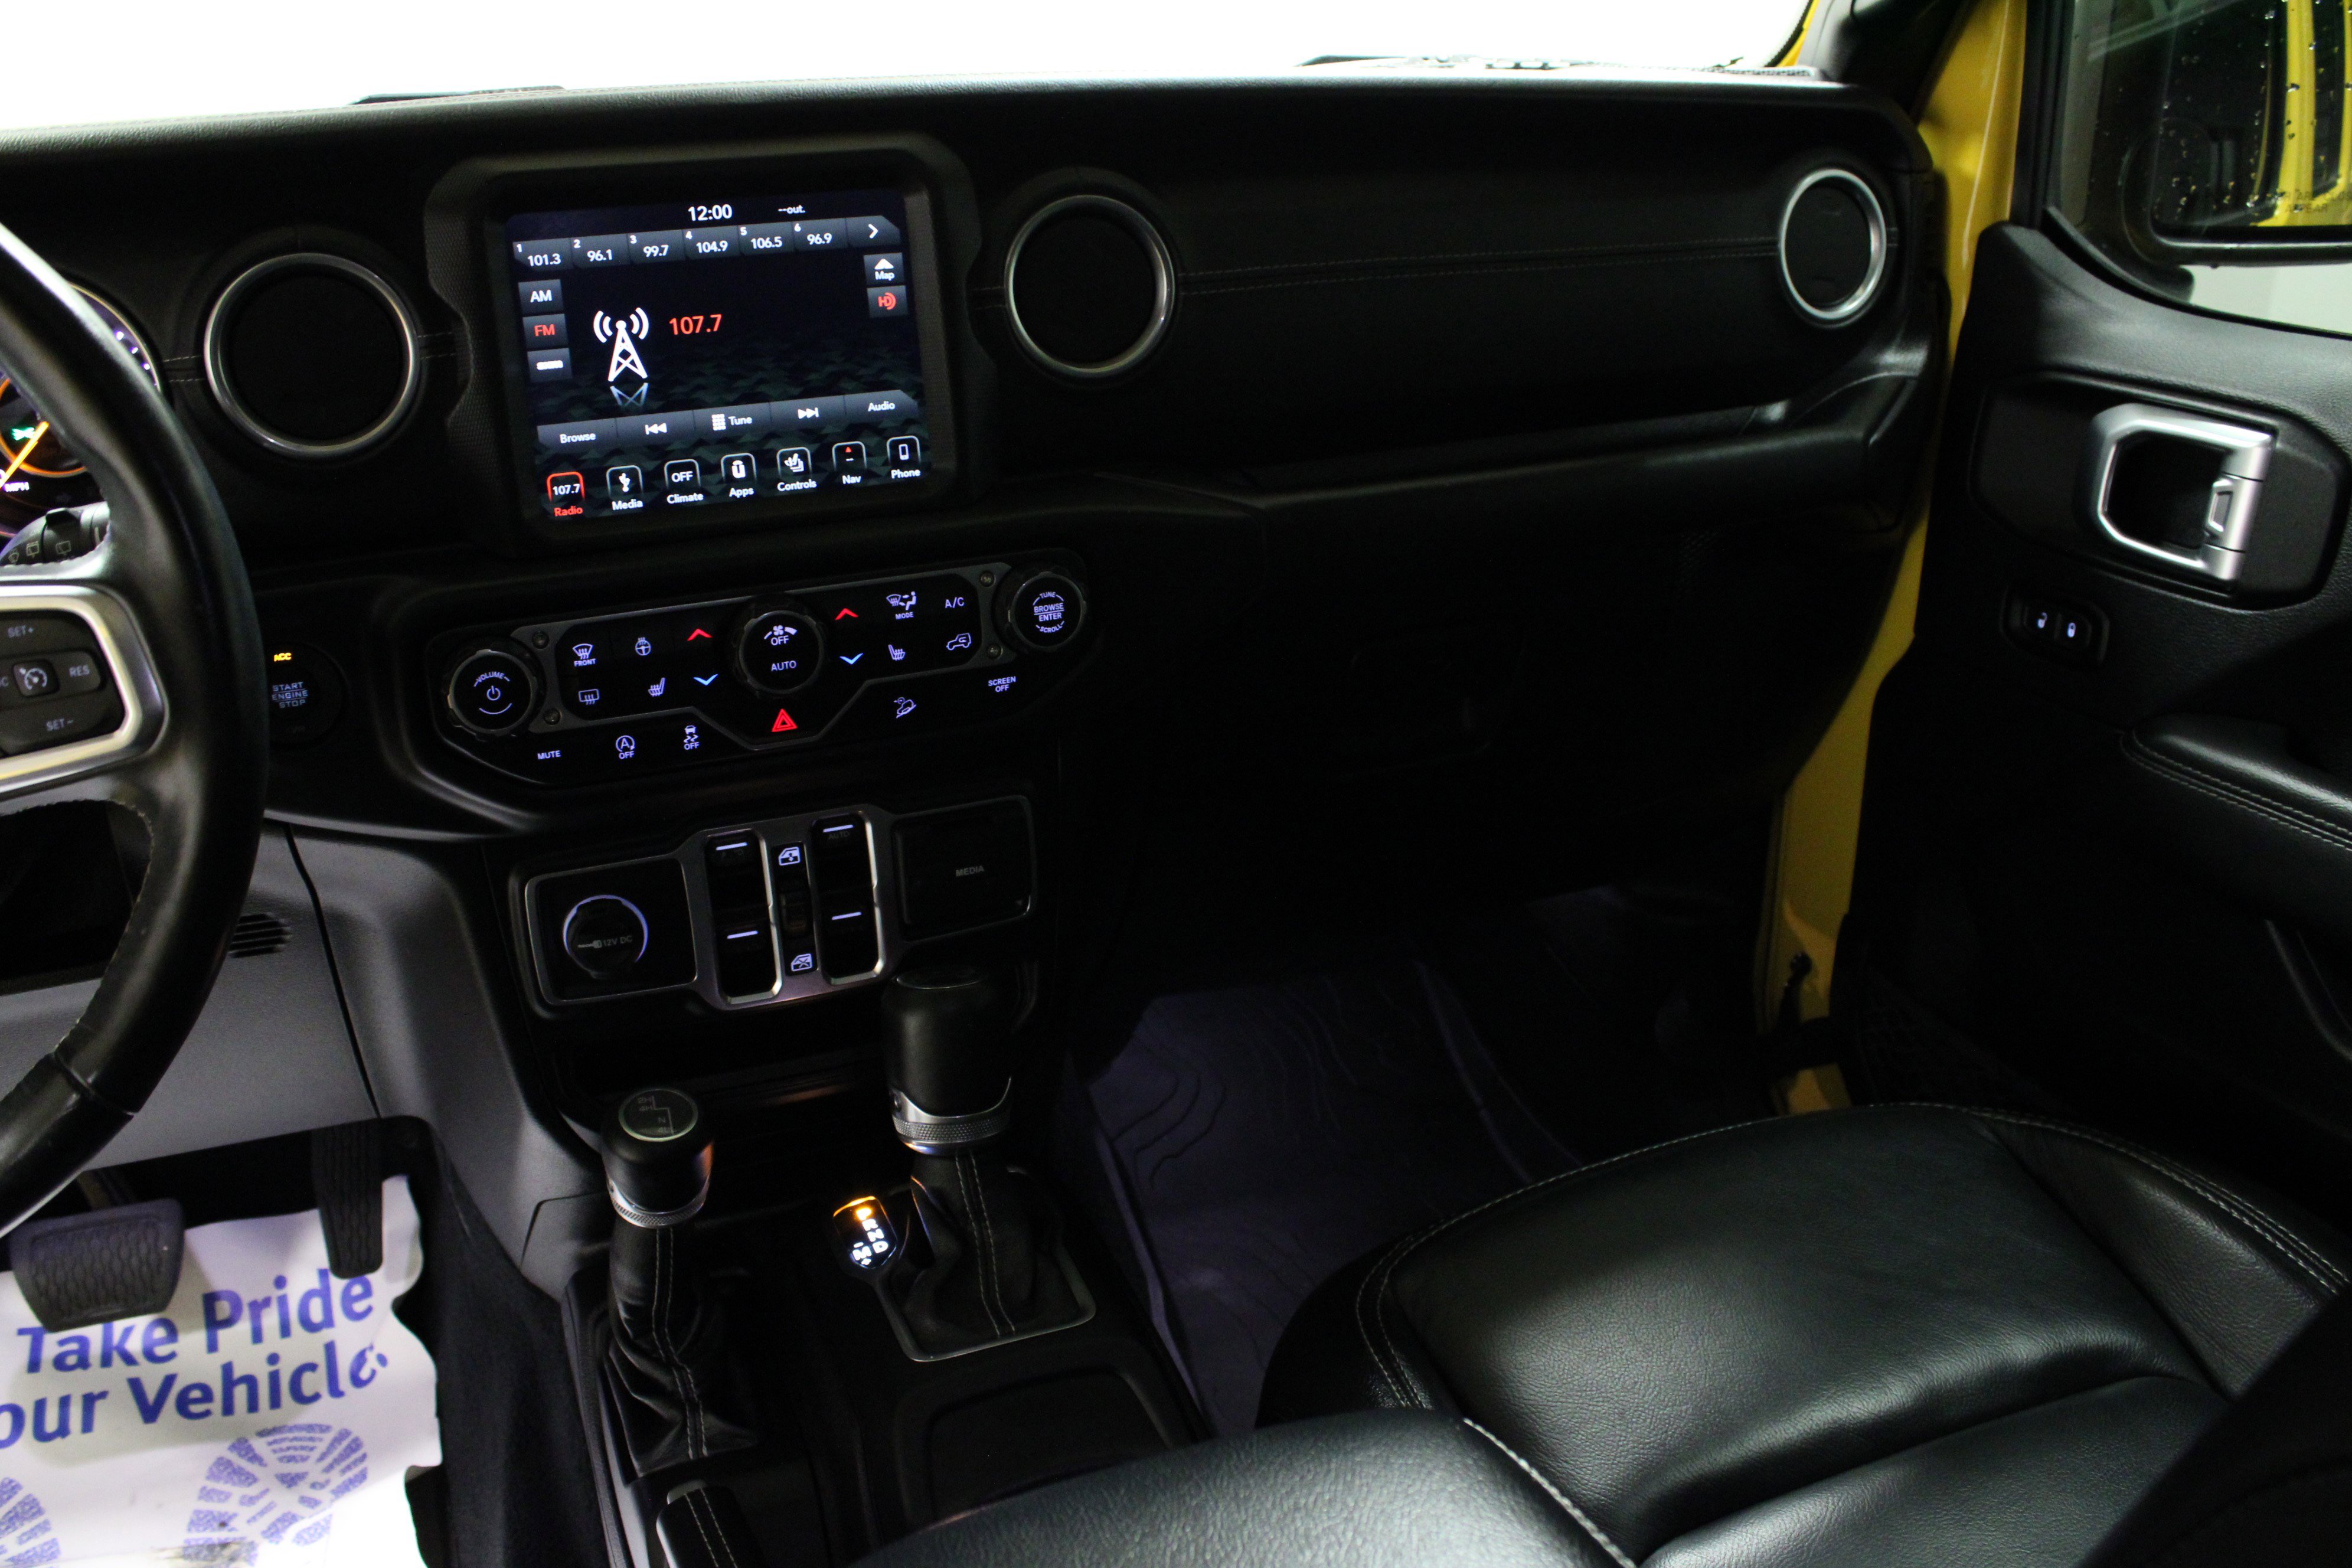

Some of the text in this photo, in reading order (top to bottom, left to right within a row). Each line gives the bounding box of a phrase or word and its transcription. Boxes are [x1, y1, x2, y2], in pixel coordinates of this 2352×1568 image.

[688, 204, 733, 221] 12:00
[740, 227, 747, 236] 5
[795, 223, 801, 232] 6
[630, 235, 637, 244] 3
[686, 231, 692, 240] 4
[807, 233, 832, 245] 96.9
[574, 239, 581, 249] 2
[696, 240, 729, 253] 104.9
[751, 236, 783, 249] 106.5
[517, 244, 522, 253] 1
[643, 244, 669, 257] 99.7
[528, 253, 562, 266] 101.3
[587, 249, 613, 262] 96.1
[875, 271, 895, 280] Map
[531, 290, 553, 302] AM
[669, 314, 721, 335] 107.7
[534, 324, 555, 336] FM
[868, 401, 896, 411] Audio
[728, 416, 753, 425] Tune
[560, 433, 596, 443] Browse
[672, 471, 693, 482] OFF
[891, 469, 921, 479] Phone
[842, 475, 861, 484] Nav
[553, 483, 580, 496] 107.7
[778, 479, 817, 491] Controls
[729, 488, 754, 498] Apps
[667, 493, 704, 504] Climate
[612, 499, 643, 510] Media
[554, 506, 583, 517] Radio
[945, 597, 965, 609] A/C
[1034, 602, 1064, 613] BROWSE
[1038, 612, 1062, 622] ENTER
[1040, 624, 1063, 633] SCROLL
[770, 635, 789, 645] OFF
[274, 653, 292, 662] ACC
[574, 658, 596, 667] FRONT
[772, 661, 796, 671] AUTO
[68, 665, 90, 678] RES
[476, 671, 505, 682] VOLUME
[273, 682, 303, 691] START
[988, 677, 1016, 687] SCREEN
[272, 690, 308, 700] ENGINE
[279, 699, 305, 708] STOP
[684, 740, 699, 750] OFF
[538, 750, 561, 759] MUTE
[619, 750, 634, 759] OFF
[956, 865, 984, 876] MEDIA
[620, 935, 632, 944] DC
[856, 1208, 872, 1220] P
[862, 1219, 878, 1231] R
[867, 1229, 884, 1242] N
[873, 1241, 888, 1253] D
[852, 1246, 872, 1260] M
[17, 1269, 373, 1374] Take Pride
